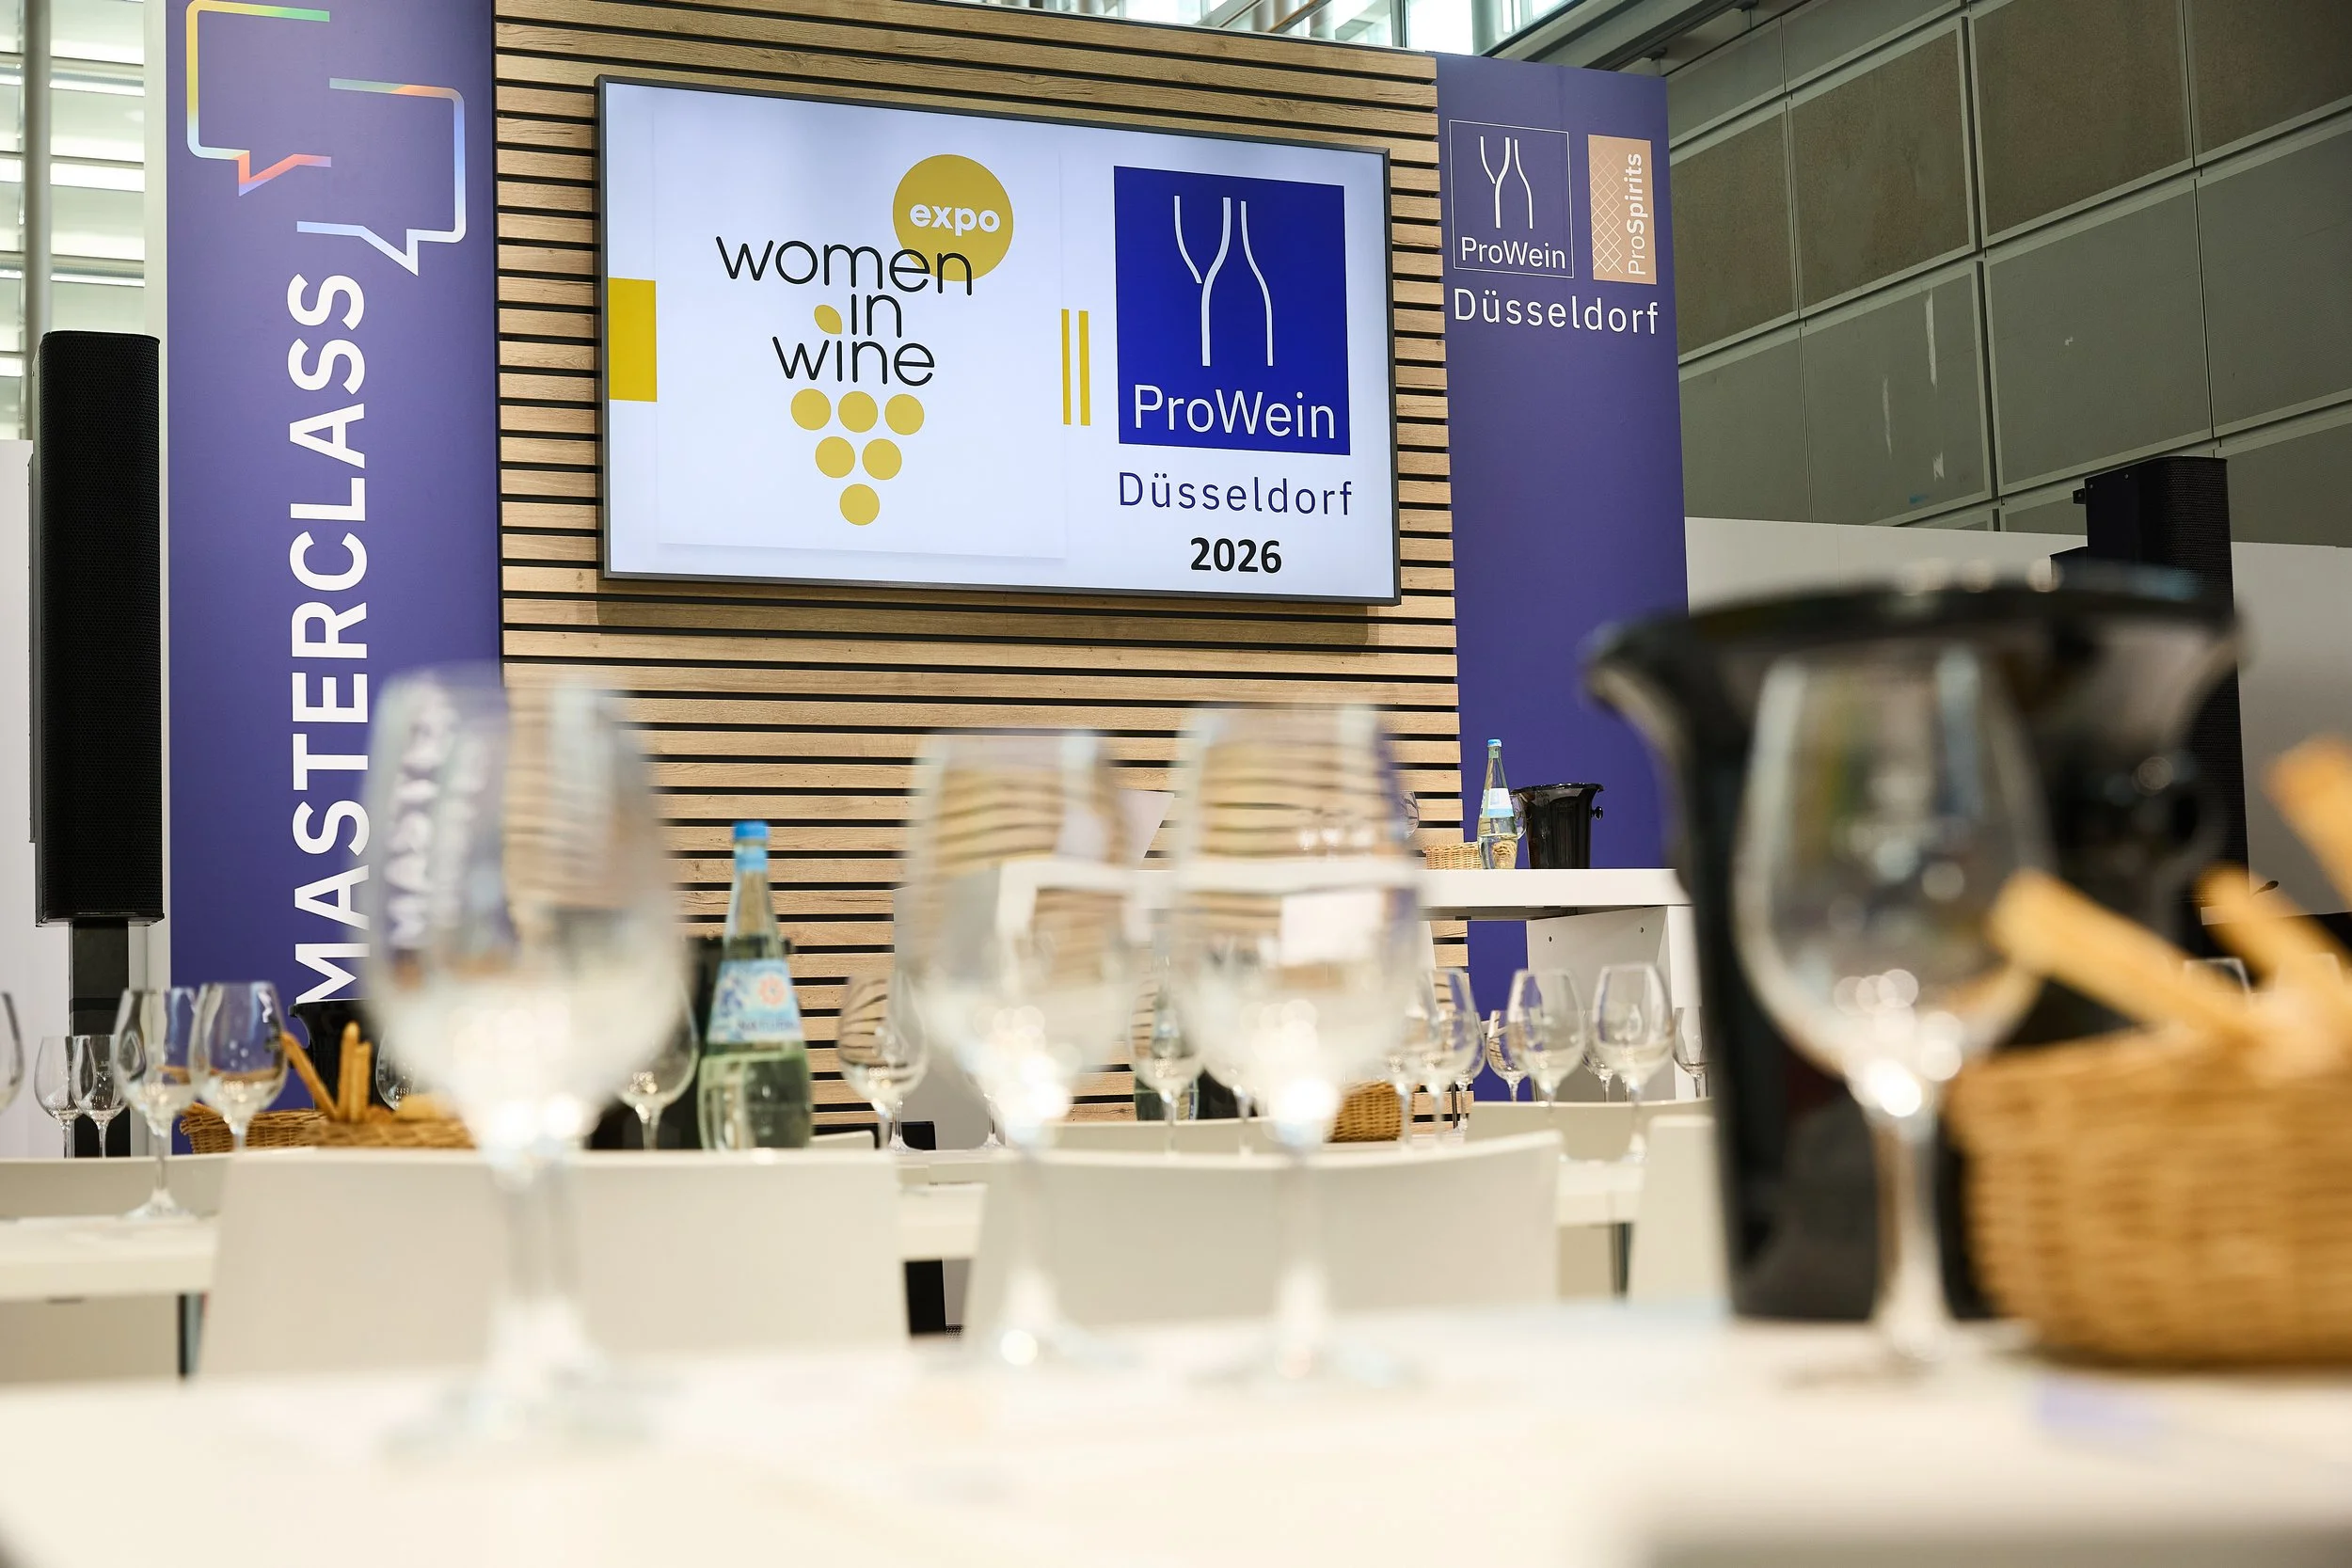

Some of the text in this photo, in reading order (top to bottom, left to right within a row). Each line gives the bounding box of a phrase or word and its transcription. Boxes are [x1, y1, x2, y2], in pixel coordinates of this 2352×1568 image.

[910, 202, 1001, 236] expo
[1624, 152, 1649, 277] ProSpirits
[715, 236, 973, 296] women
[1460, 236, 1566, 269] ProWein
[850, 293, 902, 339] in
[1454, 287, 1659, 334] Düsseldorf
[771, 335, 935, 387] wine
[1135, 384, 1335, 439] ProWein
[1119, 471, 1353, 516] Düsseldorf
[1190, 537, 1282, 574] 2026
[286, 273, 371, 1005] MASTERCLASS
